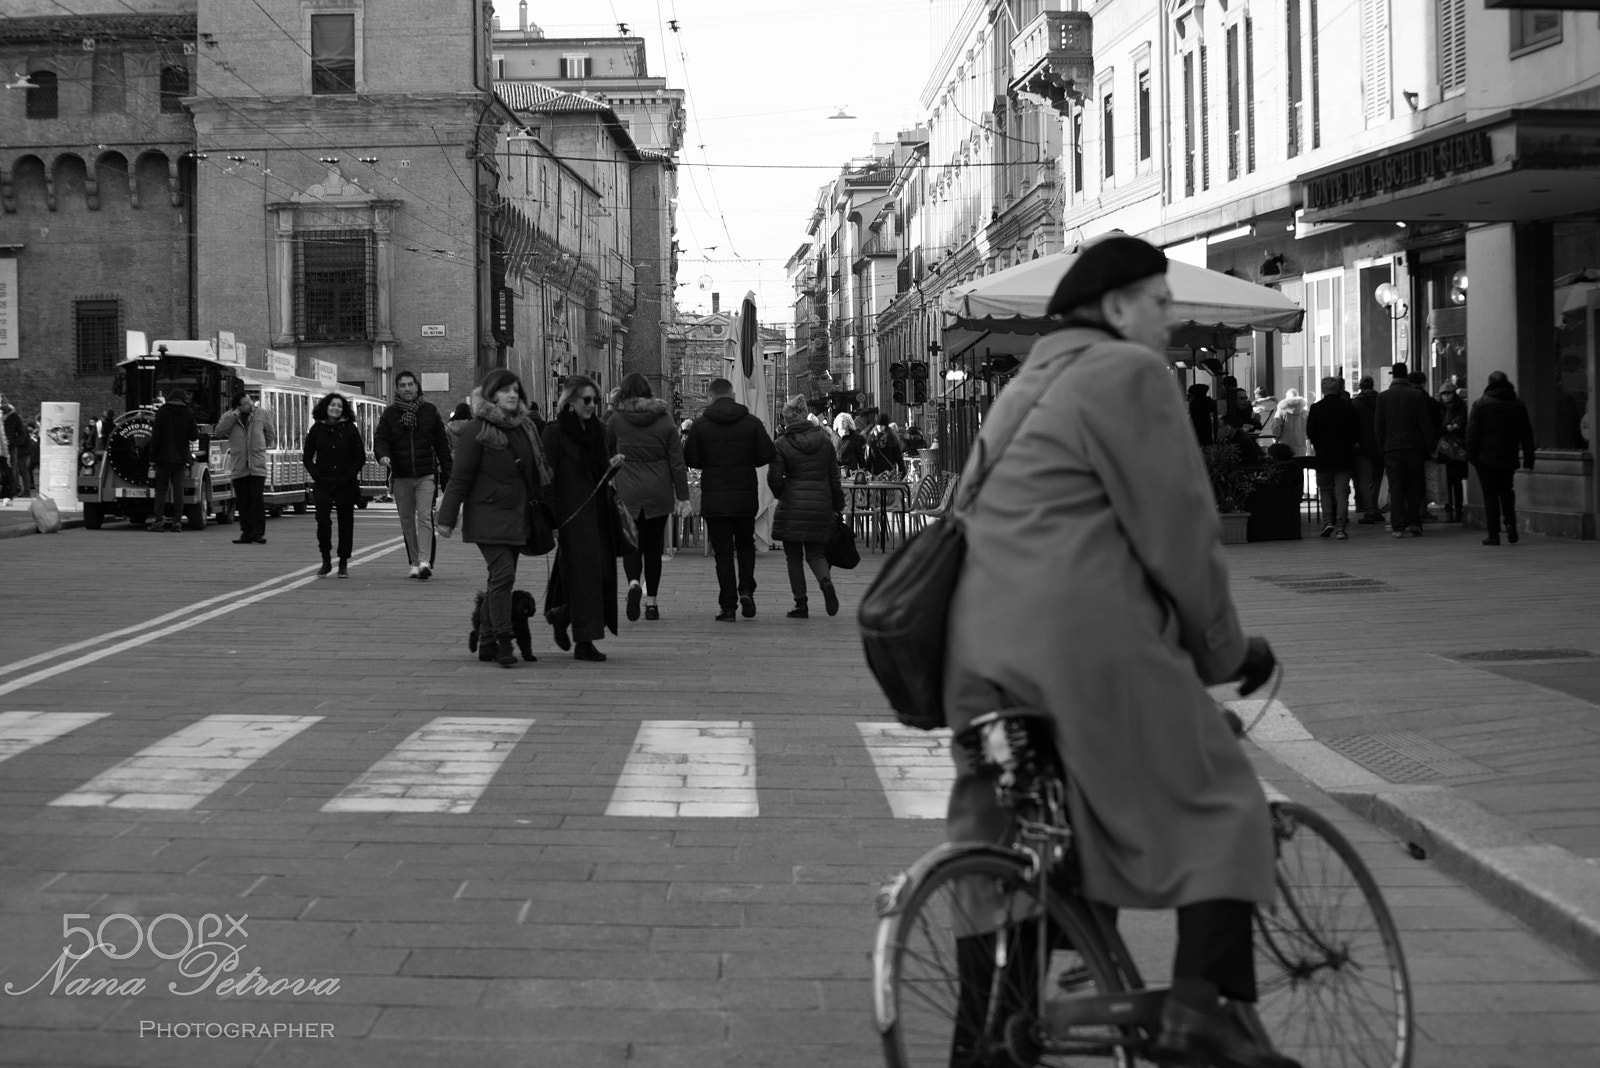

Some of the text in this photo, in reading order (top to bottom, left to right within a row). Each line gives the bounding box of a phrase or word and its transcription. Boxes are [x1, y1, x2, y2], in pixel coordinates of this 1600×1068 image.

[1349, 165, 1368, 198] DEI
[1371, 151, 1417, 191] PASCHI
[1421, 146, 1435, 177] DI
[1440, 132, 1483, 172] SIENA
[119, 423, 153, 437] DOTTO TRA
